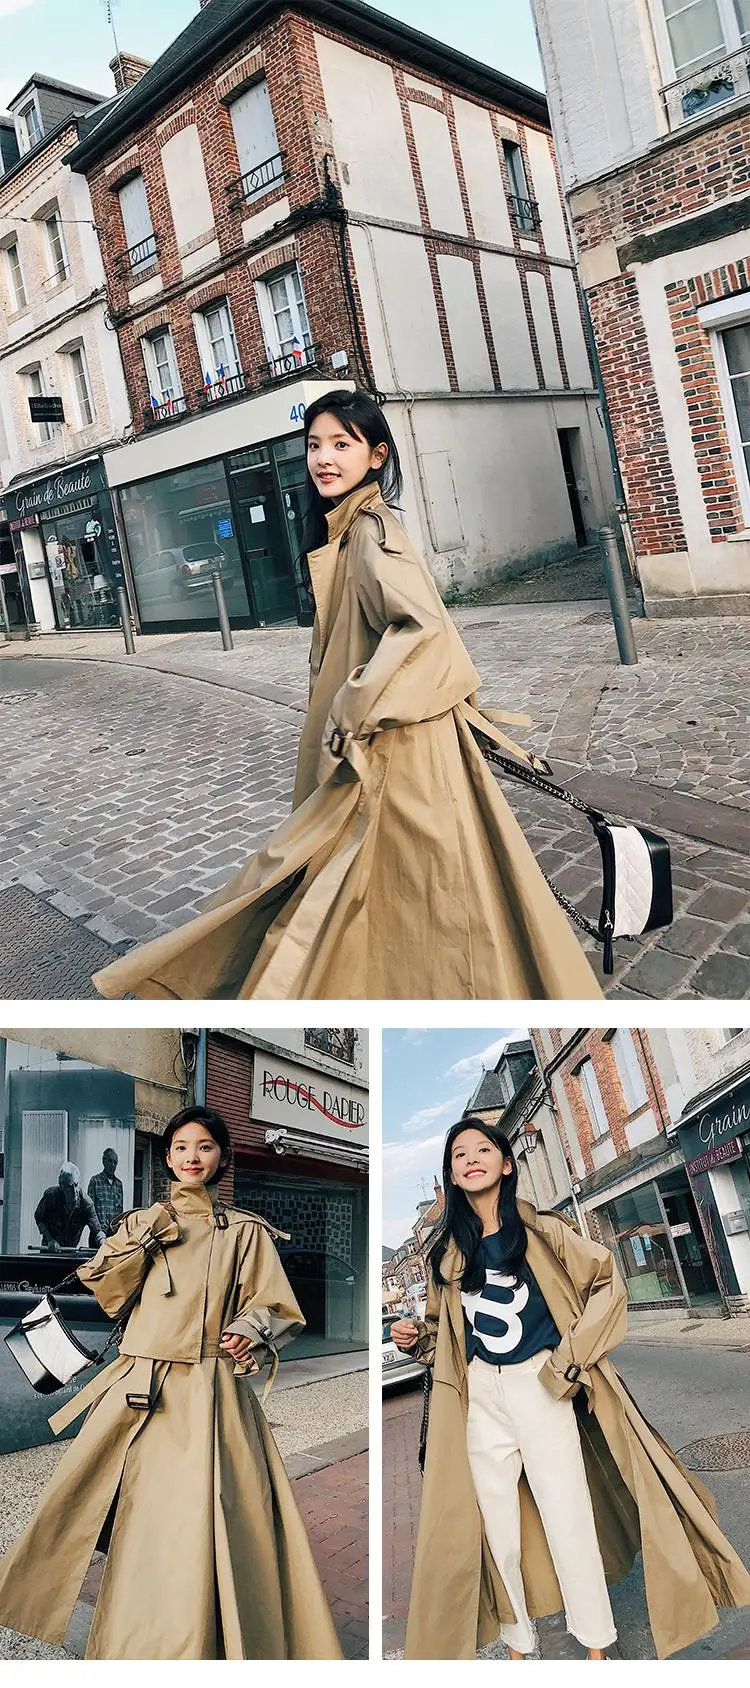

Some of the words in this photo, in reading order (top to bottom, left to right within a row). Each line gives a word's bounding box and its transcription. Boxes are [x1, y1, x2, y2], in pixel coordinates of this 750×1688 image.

[16, 491, 42, 517] Grain
[43, 480, 54, 504] de
[54, 468, 91, 499] Beauté
[262, 1070, 316, 1111] ROUGE
[323, 1091, 365, 1124] PAPIER
[699, 1104, 750, 1150] Grain
